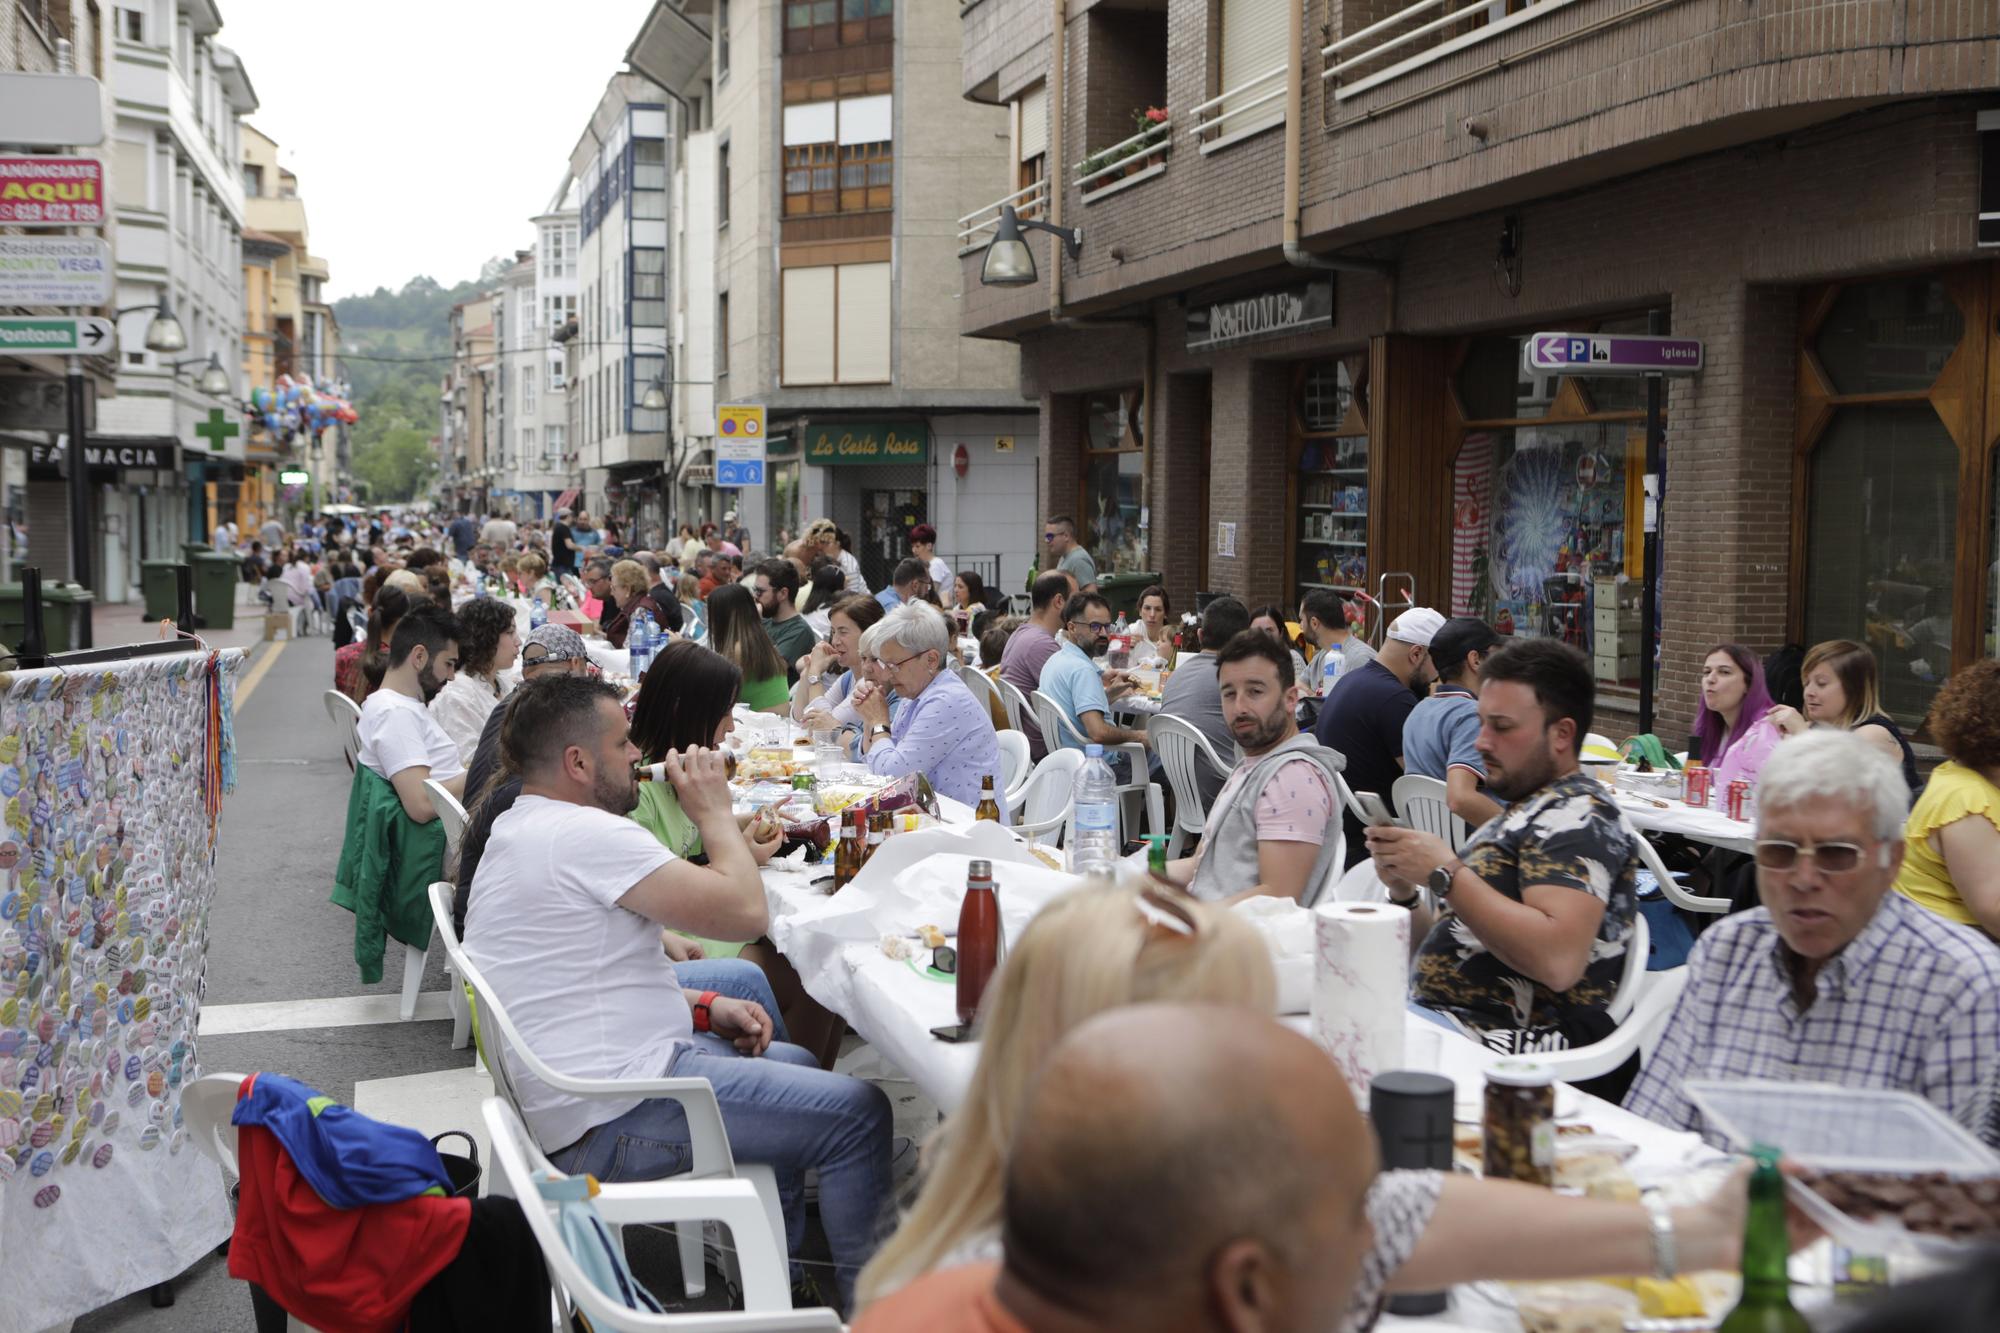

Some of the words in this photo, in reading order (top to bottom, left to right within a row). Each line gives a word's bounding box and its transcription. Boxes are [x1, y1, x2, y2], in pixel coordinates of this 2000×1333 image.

[2, 179, 95, 203] AQUÍ
[1234, 293, 1289, 338] HOME
[1571, 340, 1585, 360] P
[1661, 347, 1697, 359] Iglesia
[811, 433, 833, 456] La
[883, 431, 921, 455] Rosa
[32, 446, 157, 466] FAMACIA
